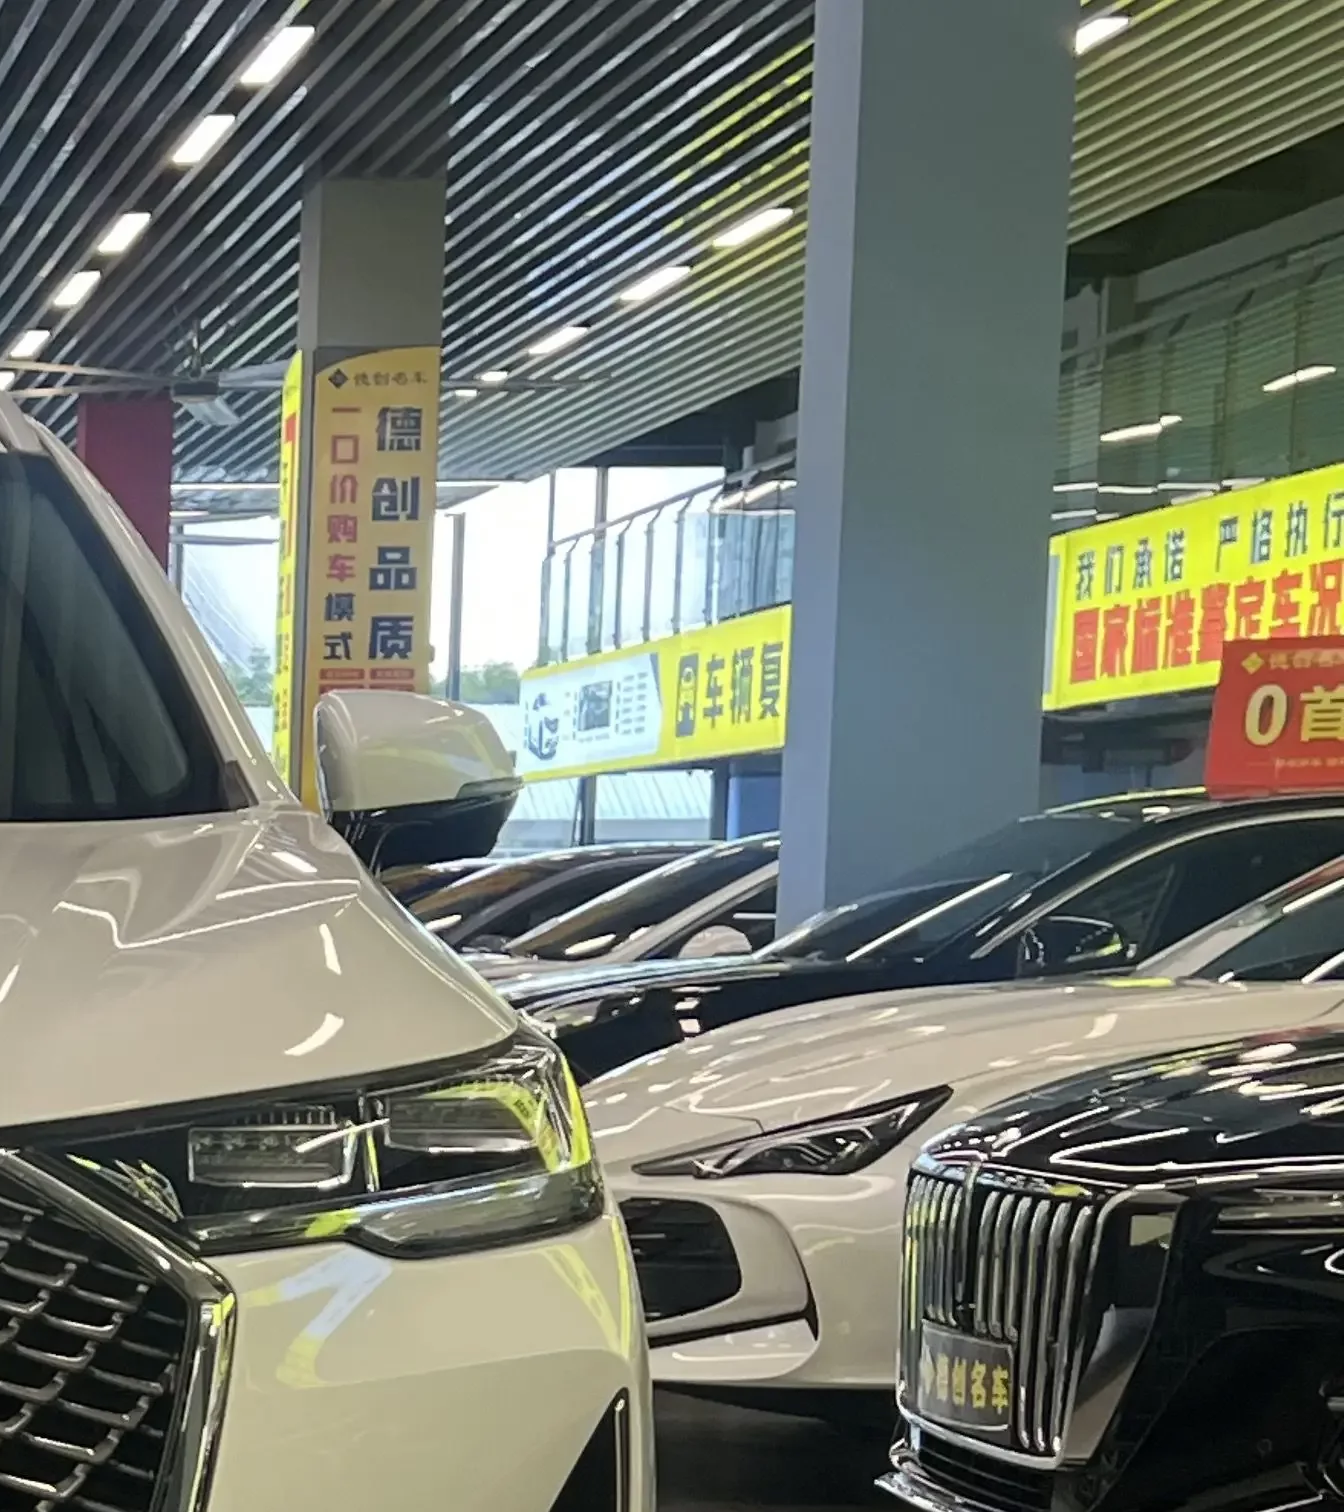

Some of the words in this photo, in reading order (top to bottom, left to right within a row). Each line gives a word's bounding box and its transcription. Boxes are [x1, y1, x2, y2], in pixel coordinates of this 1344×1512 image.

[324, 406, 361, 661] 一口价购车模式
[368, 406, 423, 660] 德创品质
